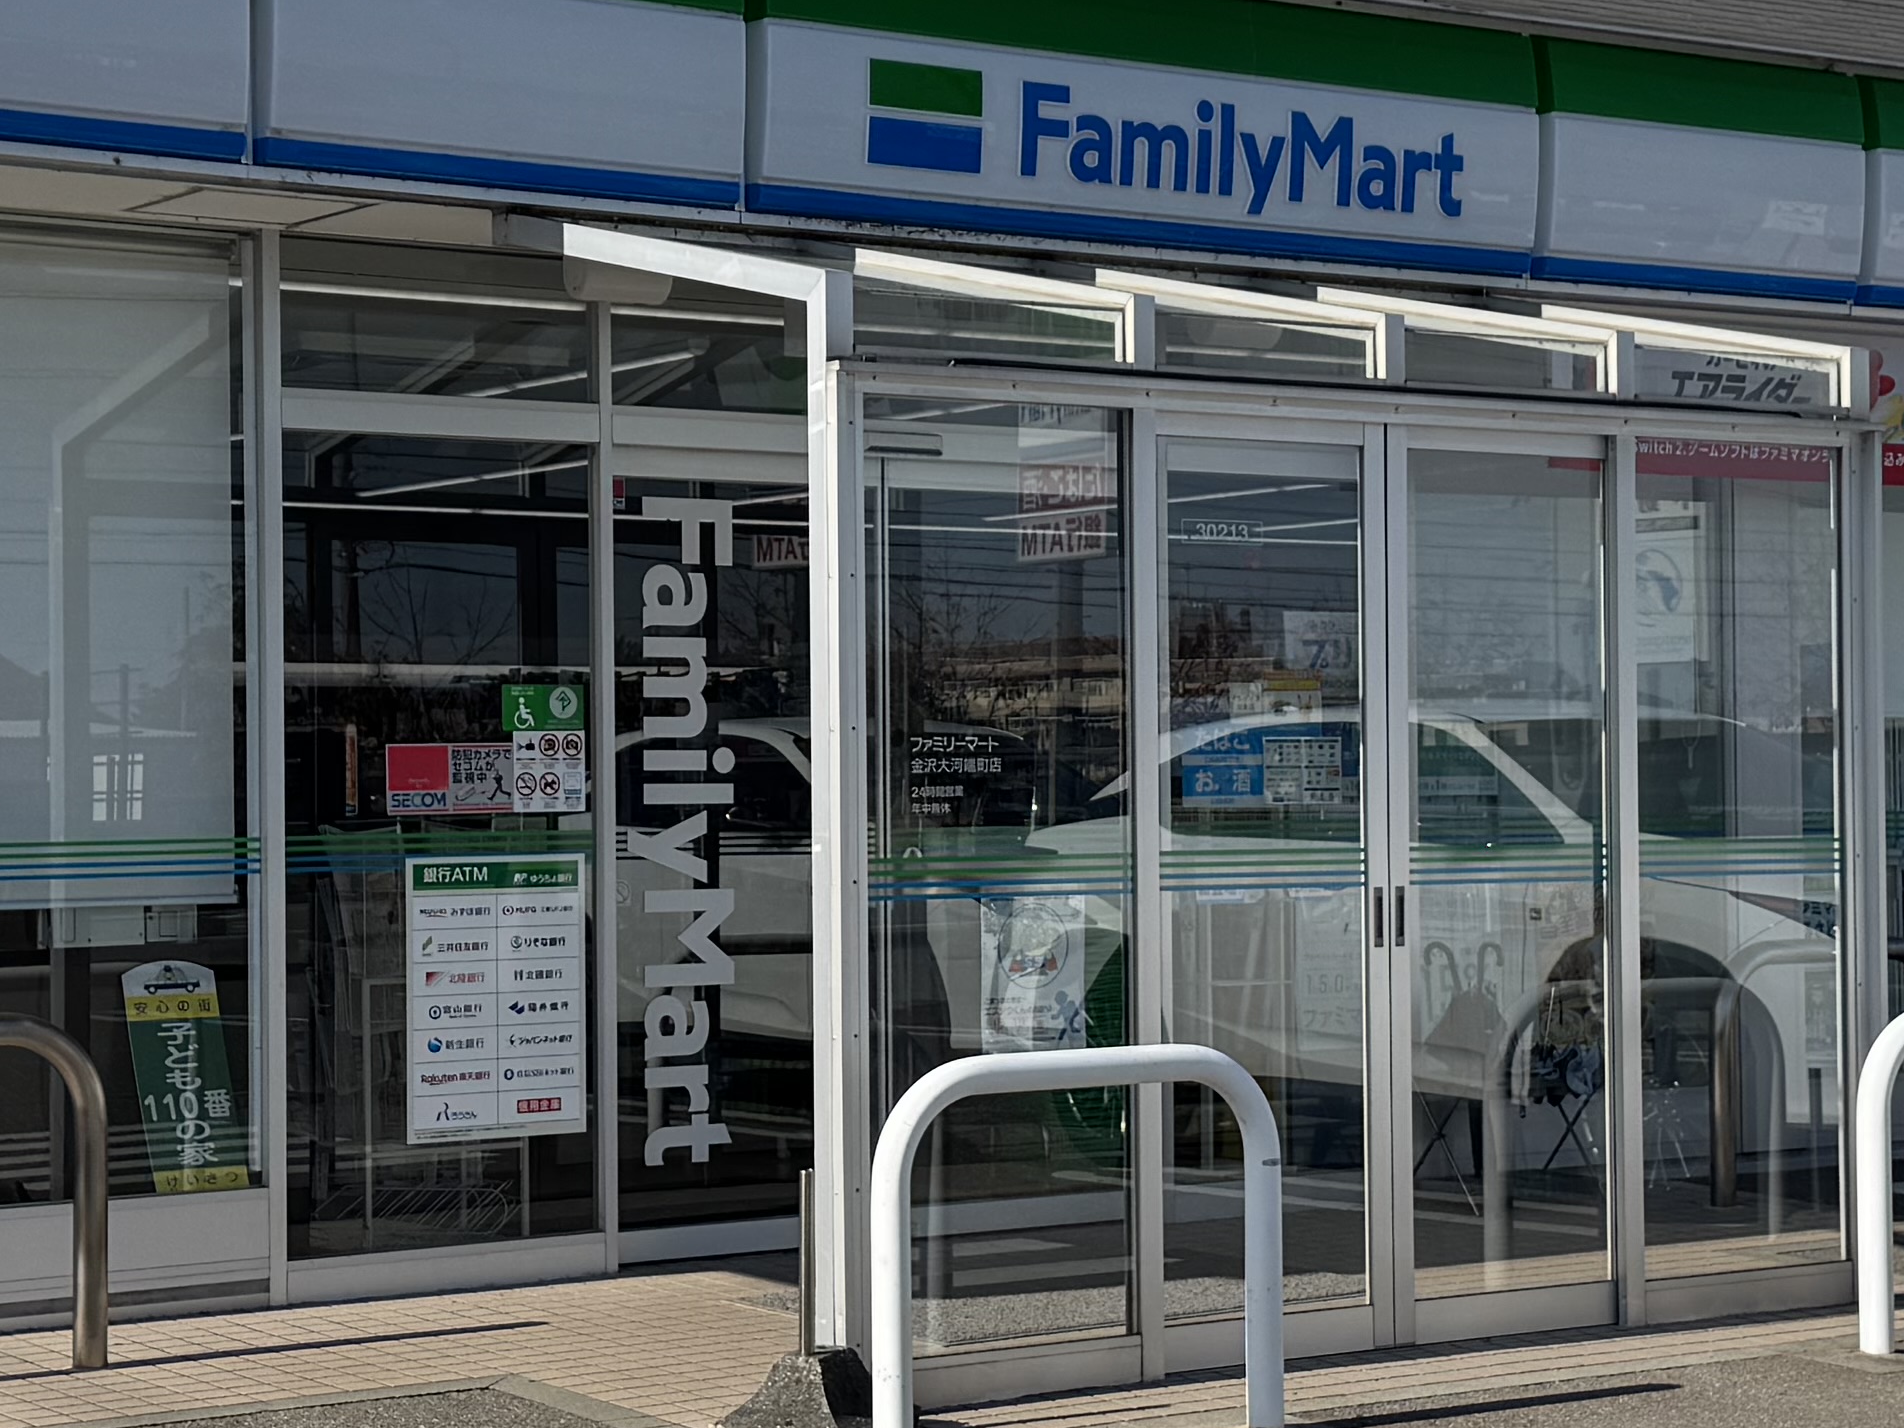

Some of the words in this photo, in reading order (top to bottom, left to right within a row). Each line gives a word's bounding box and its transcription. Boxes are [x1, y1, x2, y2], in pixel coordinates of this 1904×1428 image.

[1020, 79, 1464, 217] FamilyMart
[910, 736, 999, 753] ファミリーマート
[391, 793, 447, 808] SECOM
[627, 495, 735, 1167] FamilyMart
[423, 866, 488, 883] 銀行ATM
[134, 999, 211, 1014] 安心の街
[166, 1171, 238, 1188] けいさつ
